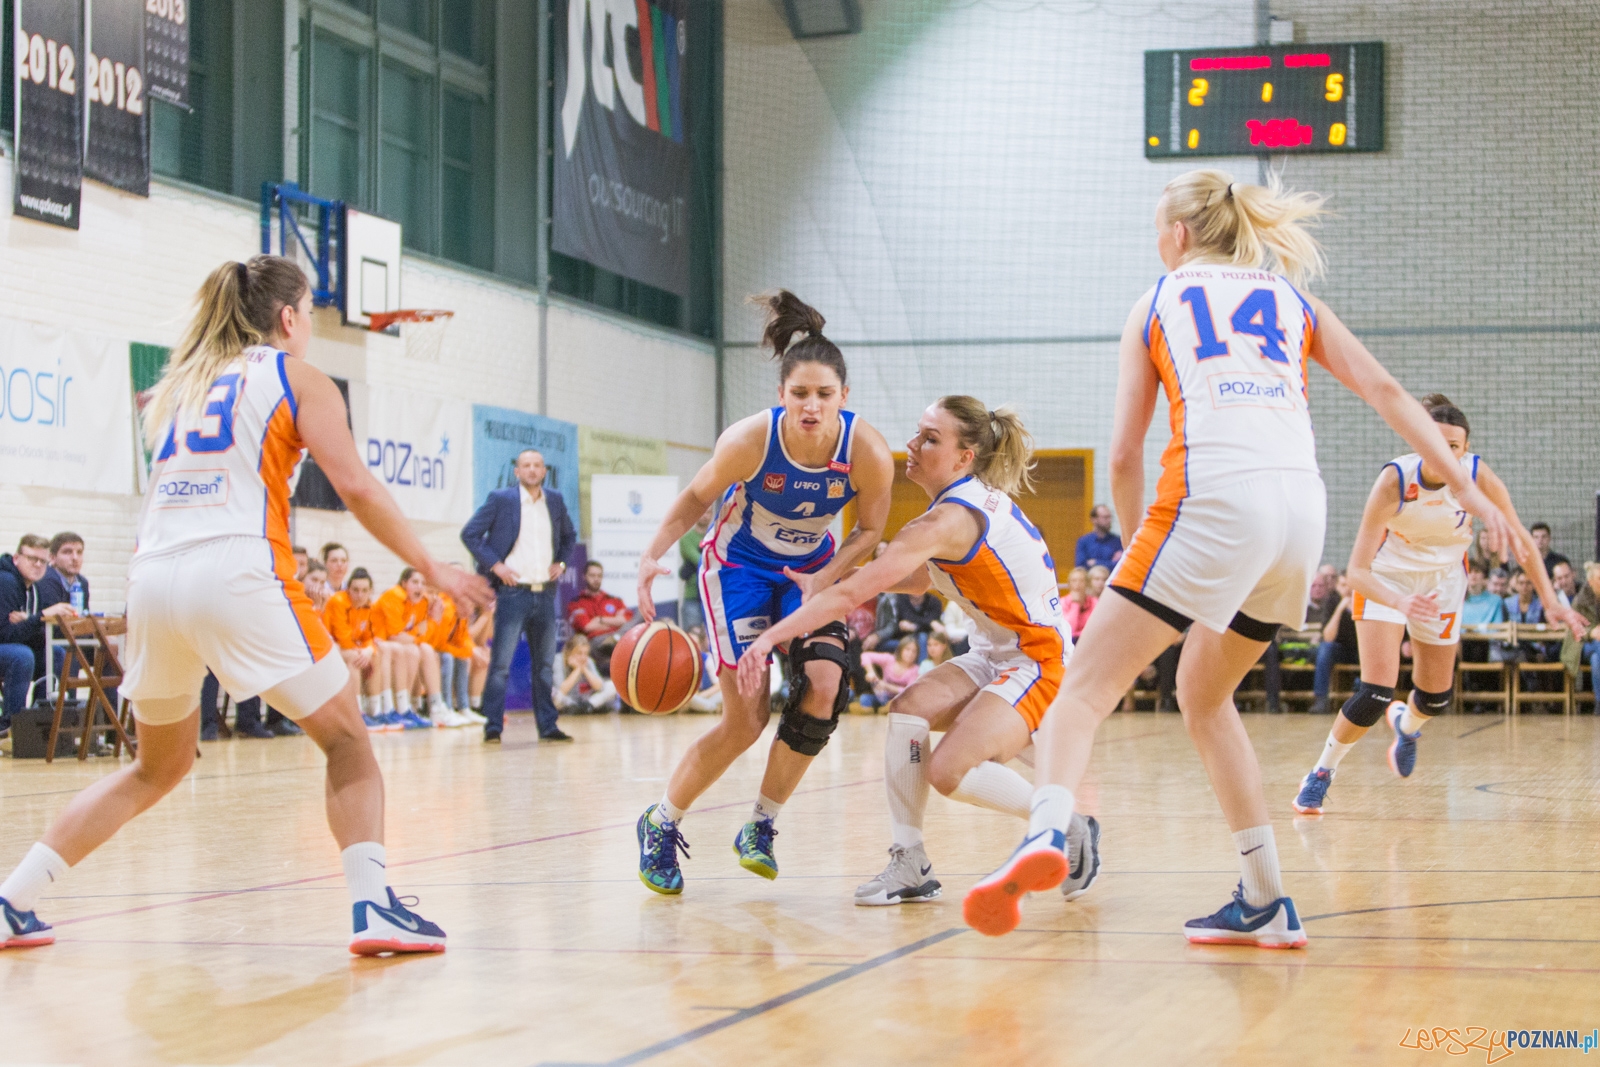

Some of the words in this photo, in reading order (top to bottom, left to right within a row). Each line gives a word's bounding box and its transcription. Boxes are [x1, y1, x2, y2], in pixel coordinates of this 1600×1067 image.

[20, 29, 77, 96] 2012
[89, 52, 143, 116] 2012
[1188, 78, 1209, 106] 2
[1261, 82, 1273, 103] 1
[1325, 73, 1344, 102] 5
[1187, 129, 1199, 149] 1
[1329, 123, 1347, 146] 0
[1174, 271, 1213, 280] MUKS
[1179, 285, 1290, 367] 14
[0, 357, 72, 428] osir
[1438, 612, 1457, 640] 7
